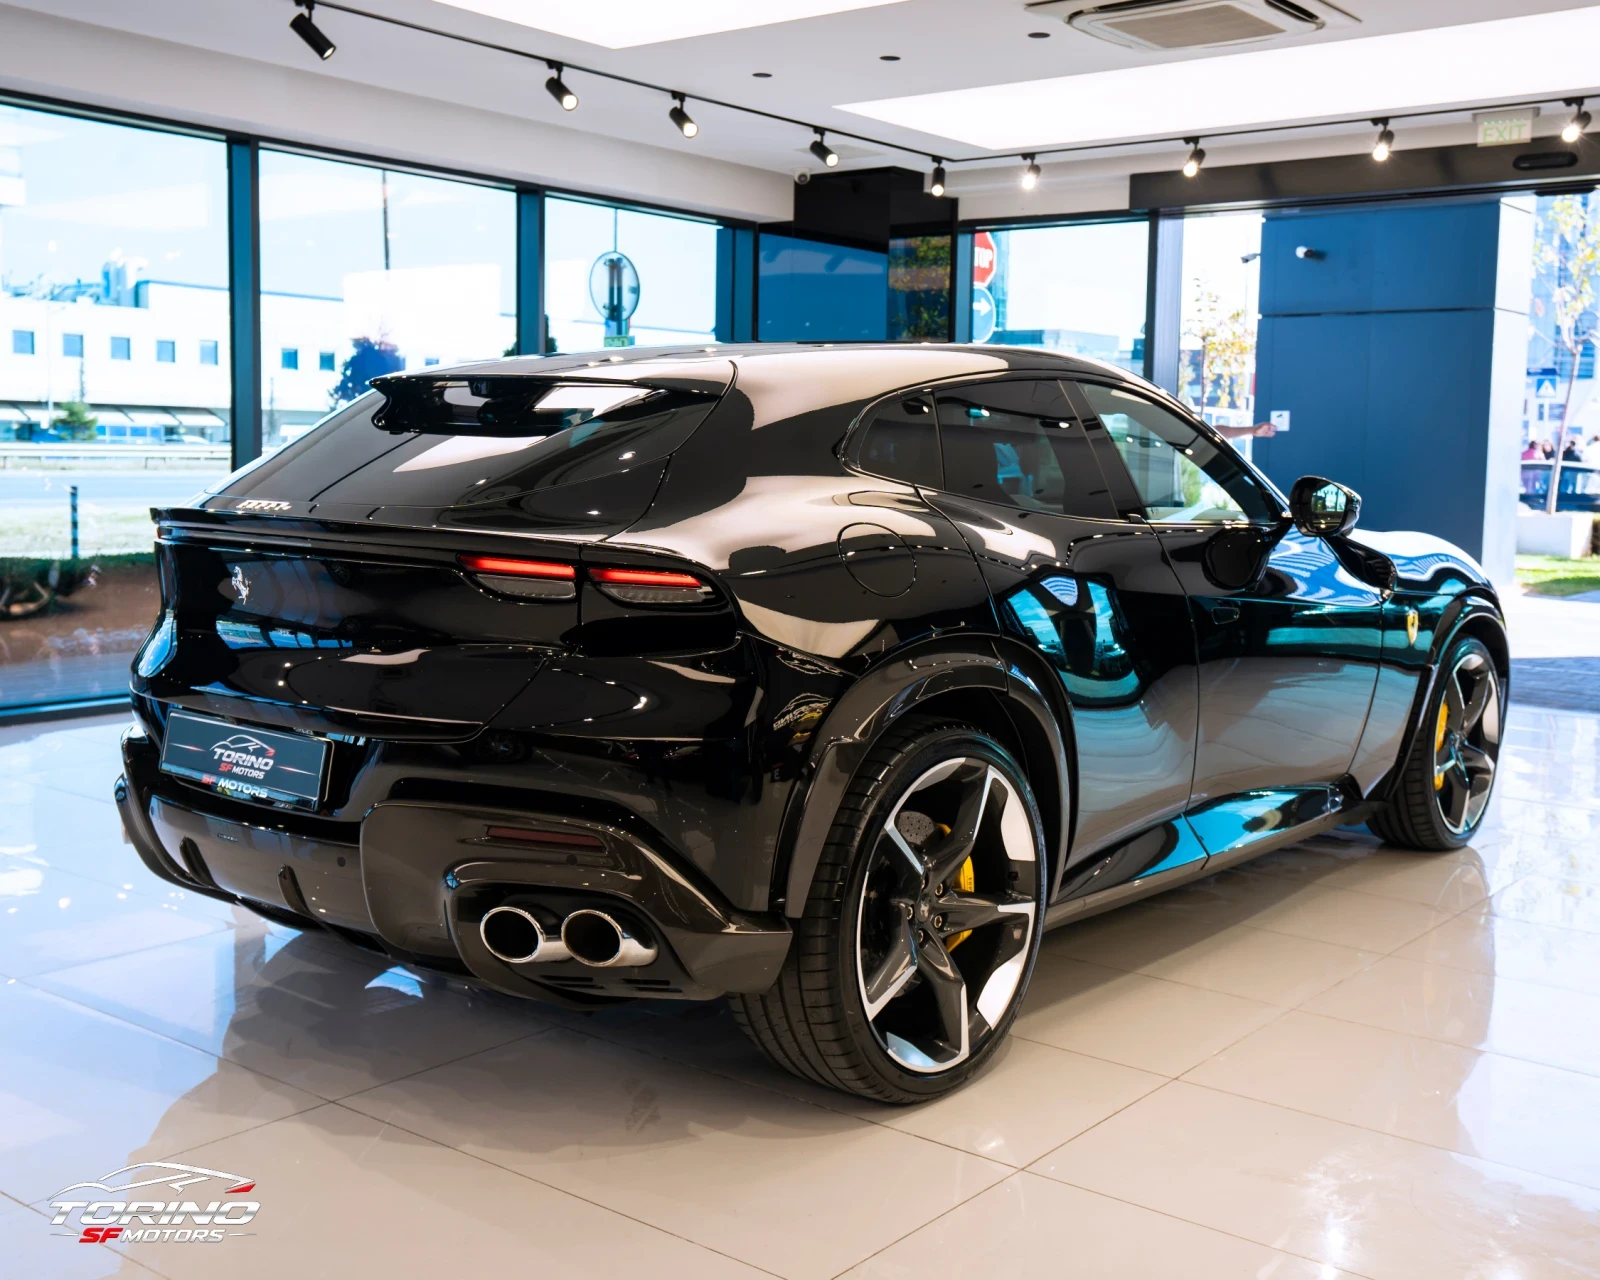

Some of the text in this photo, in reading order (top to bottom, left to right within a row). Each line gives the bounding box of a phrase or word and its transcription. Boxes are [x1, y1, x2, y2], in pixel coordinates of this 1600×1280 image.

[1483, 124, 1526, 145] EXIT
[974, 246, 993, 268] TOP
[213, 748, 274, 770] TORINO
[219, 762, 265, 779] SF MOTORS
[201, 774, 268, 798] SF MOTORS
